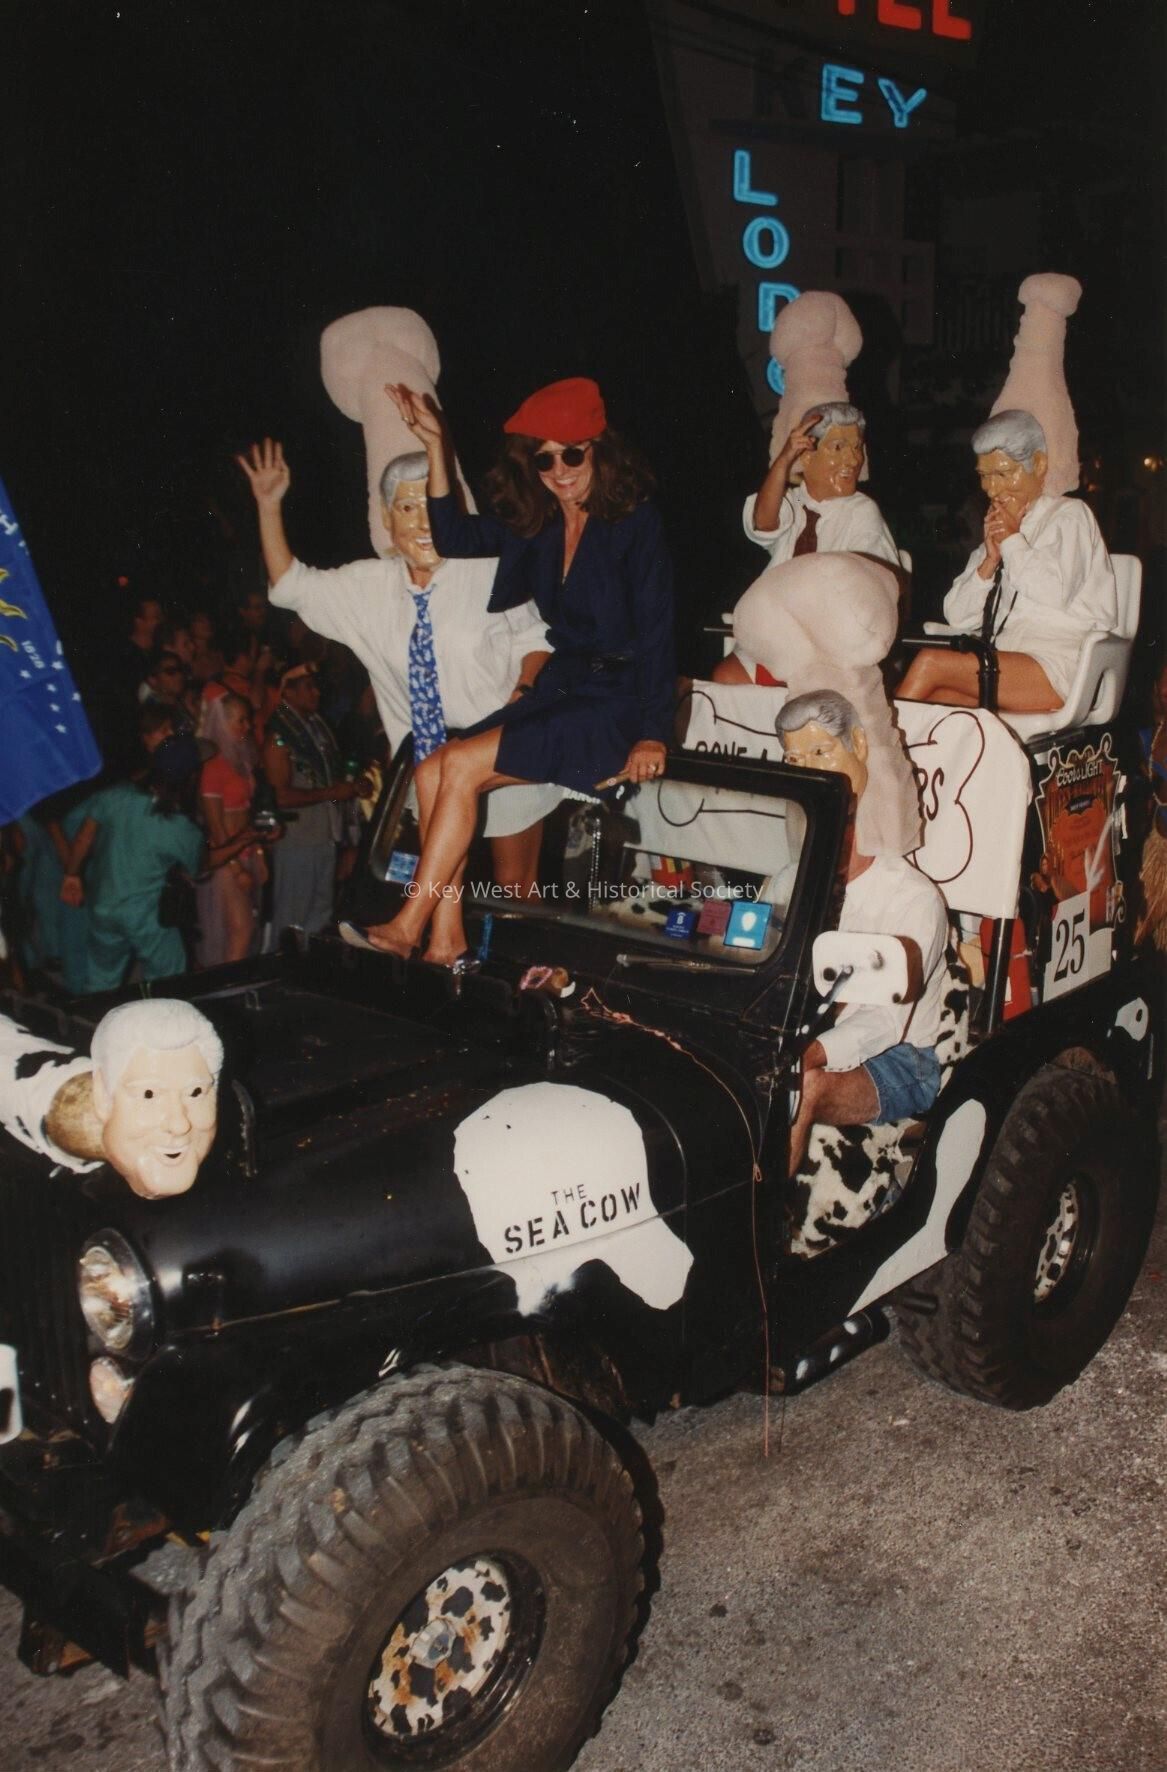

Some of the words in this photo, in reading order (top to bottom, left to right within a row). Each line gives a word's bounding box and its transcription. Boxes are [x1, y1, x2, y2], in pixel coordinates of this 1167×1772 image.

[1053, 908, 1085, 983] 25
[504, 1210, 570, 1254] SEA
[580, 1182, 641, 1230] COW
[551, 1183, 588, 1206] THE
